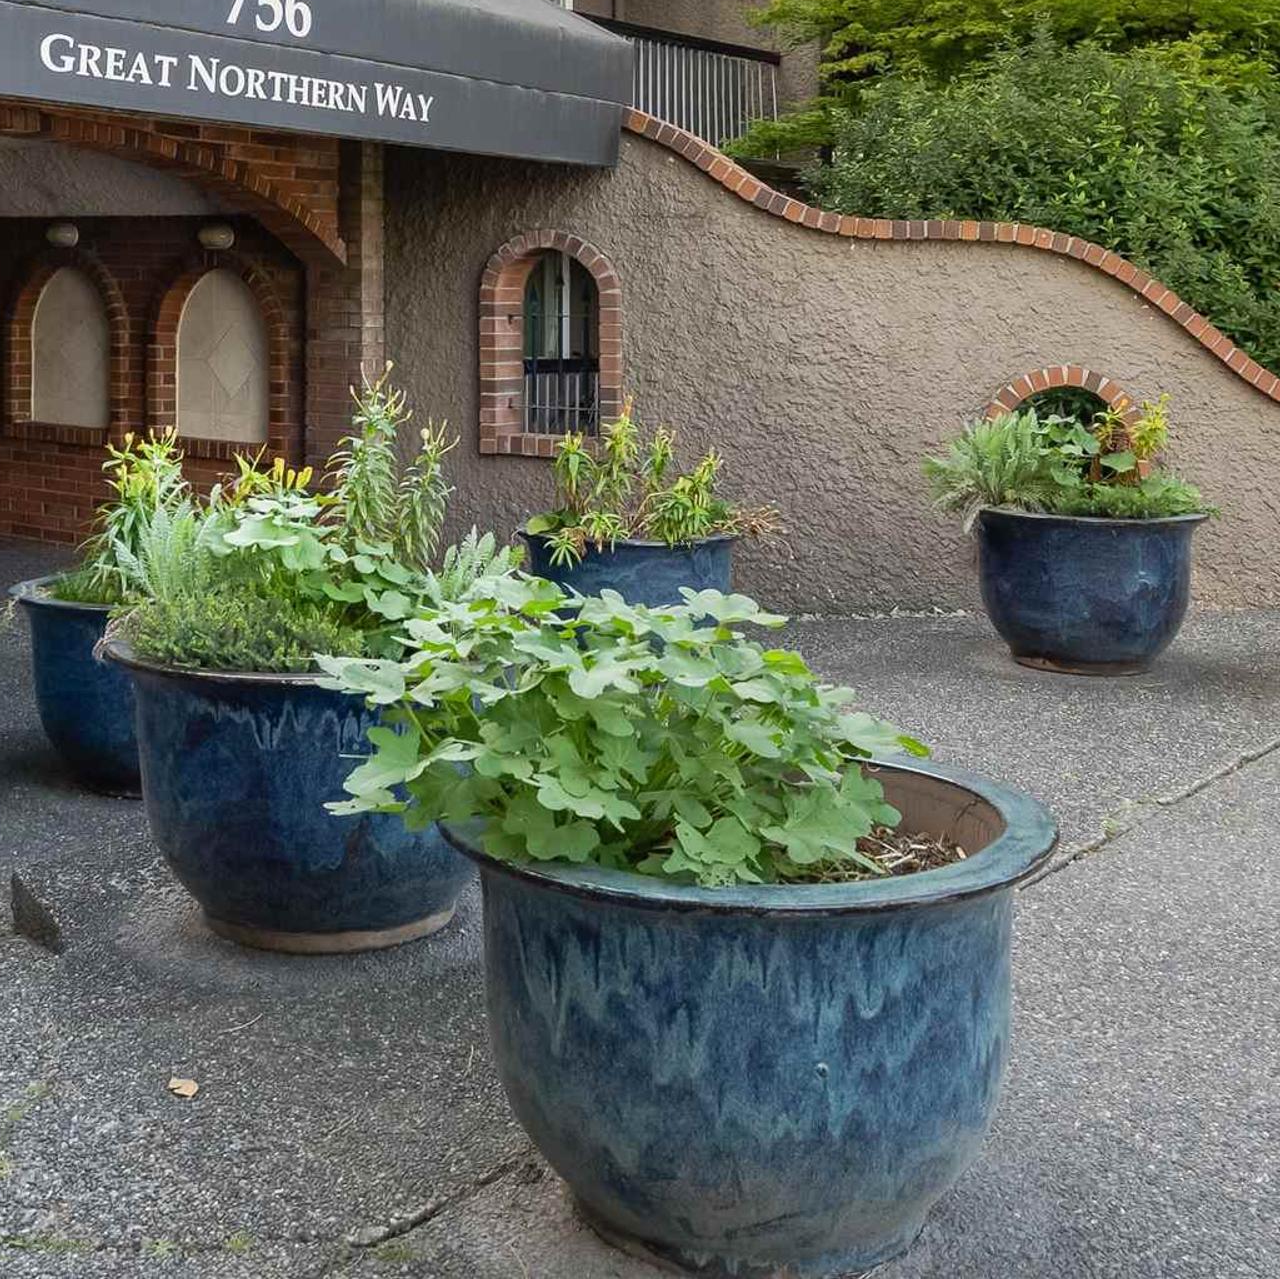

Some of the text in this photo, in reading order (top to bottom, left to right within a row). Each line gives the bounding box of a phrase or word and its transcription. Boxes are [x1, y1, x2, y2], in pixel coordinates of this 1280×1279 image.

[40, 33, 434, 122] GREAT NORTHERN WAY
